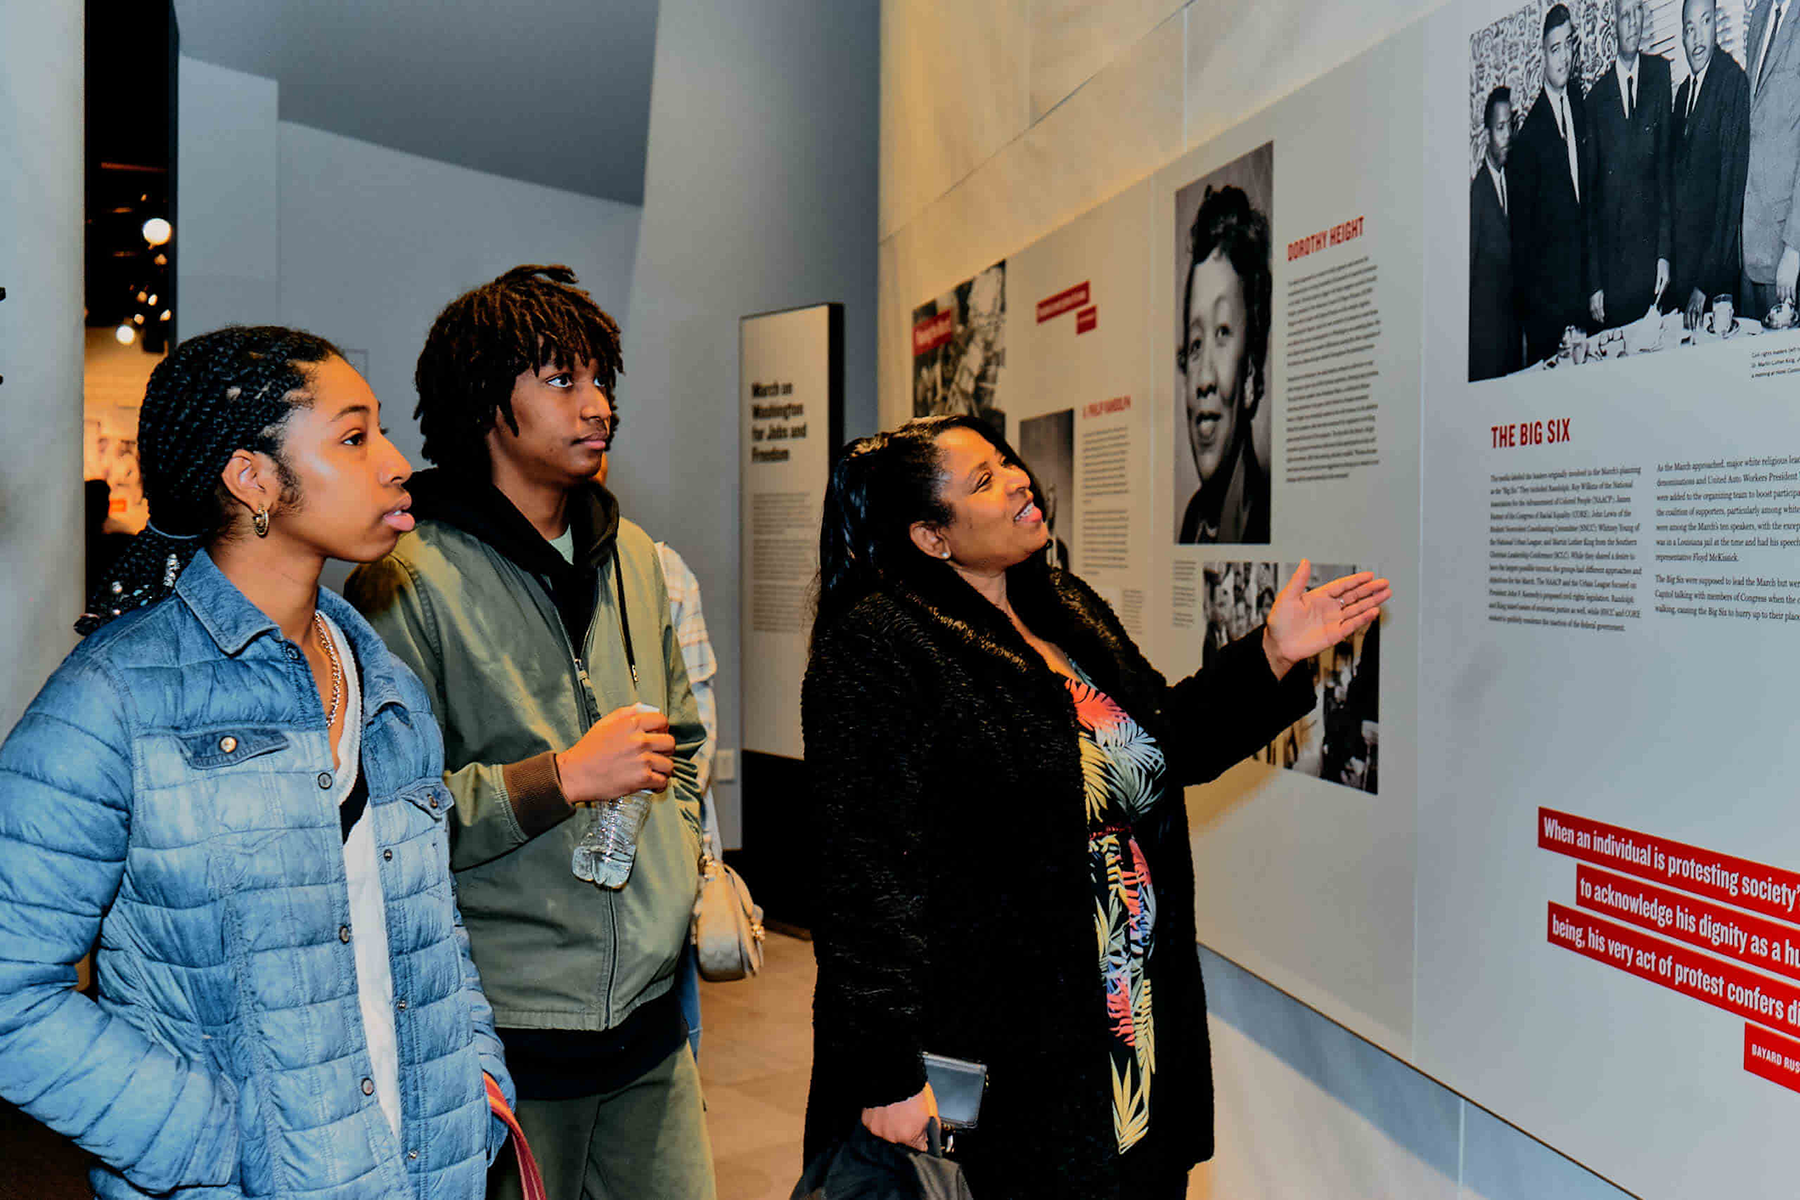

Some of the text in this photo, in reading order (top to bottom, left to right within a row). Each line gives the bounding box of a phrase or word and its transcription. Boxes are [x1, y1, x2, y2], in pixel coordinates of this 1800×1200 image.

[1288, 216, 1364, 261] DOROTHY HEIGHT
[1491, 418, 1570, 448] THE BIG SIX
[1769, 471, 1797, 482] President
[1758, 522, 1771, 530] with
[1772, 521, 1781, 530] the
[1757, 577, 1776, 587] March
[1544, 816, 1574, 845] When
[1577, 829, 1590, 849] an
[1593, 829, 1651, 867] individual
[1654, 846, 1665, 870] is
[1668, 854, 1739, 896] protesting
[1580, 877, 1592, 898] to
[1594, 883, 1673, 927] acknowledge
[1676, 905, 1696, 933] his
[1699, 914, 1748, 955] dignity
[1750, 934, 1768, 957] as
[1771, 941, 1781, 962] a
[1552, 914, 1585, 948] being,
[1588, 926, 1605, 951] his
[1608, 938, 1634, 967] very
[1636, 947, 1656, 972] act
[1659, 955, 1673, 977] of
[1675, 963, 1725, 997] protest
[1727, 982, 1784, 1020] confers
[1752, 1043, 1782, 1066] BAYARD
